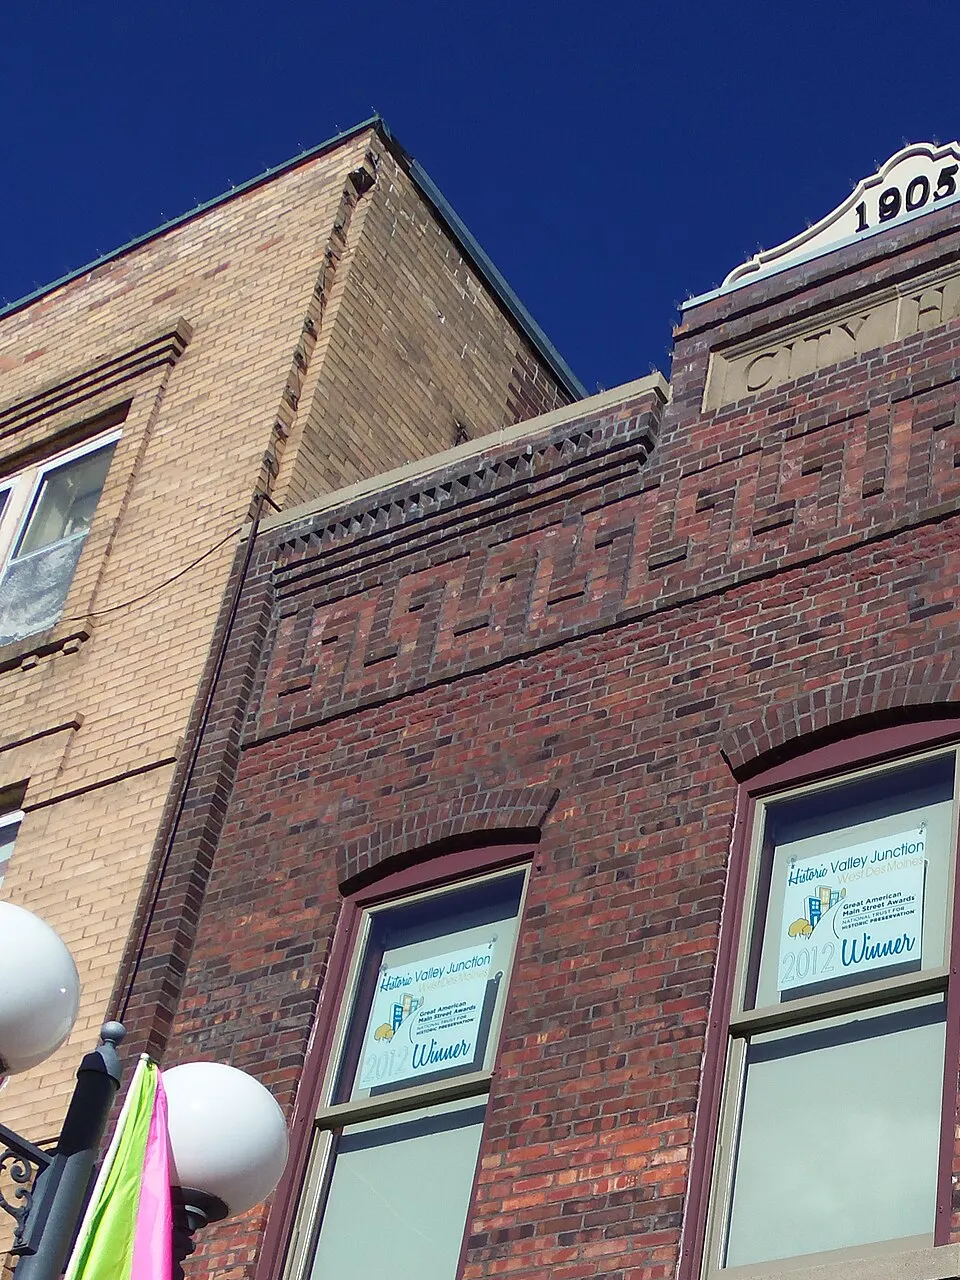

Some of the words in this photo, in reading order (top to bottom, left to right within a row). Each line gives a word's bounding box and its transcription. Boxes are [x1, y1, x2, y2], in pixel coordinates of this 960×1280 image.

[855, 164, 959, 233] 1905
[745, 313, 874, 392] CITY
[788, 864, 827, 886] Historic
[830, 854, 868, 874] Valley
[871, 841, 924, 864] Junction
[837, 868, 865, 884] West
[866, 864, 887, 878] Des
[887, 856, 924, 874] Moines
[842, 914, 871, 924] NATIONAL
[872, 910, 891, 919] TRUST
[892, 906, 905, 914] FOR
[843, 900, 864, 910] Great
[866, 892, 902, 905] American
[843, 906, 860, 916] Main
[862, 900, 885, 913] Street
[887, 895, 915, 907] Awards
[842, 920, 869, 930] HISTORIC
[870, 910, 914, 923] PRESERVATION
[781, 942, 835, 983] 2012
[842, 933, 915, 966] Winner
[380, 973, 412, 992] Historic
[415, 966, 445, 982] Valley
[447, 954, 490, 975] Junction
[418, 1013, 433, 1023] Main
[434, 1008, 452, 1020] Street
[453, 1004, 476, 1015] Awards
[419, 1007, 437, 1016] Great
[439, 1001, 466, 1013] American
[363, 1046, 409, 1082] 2012
[412, 1039, 472, 1069] Winner
